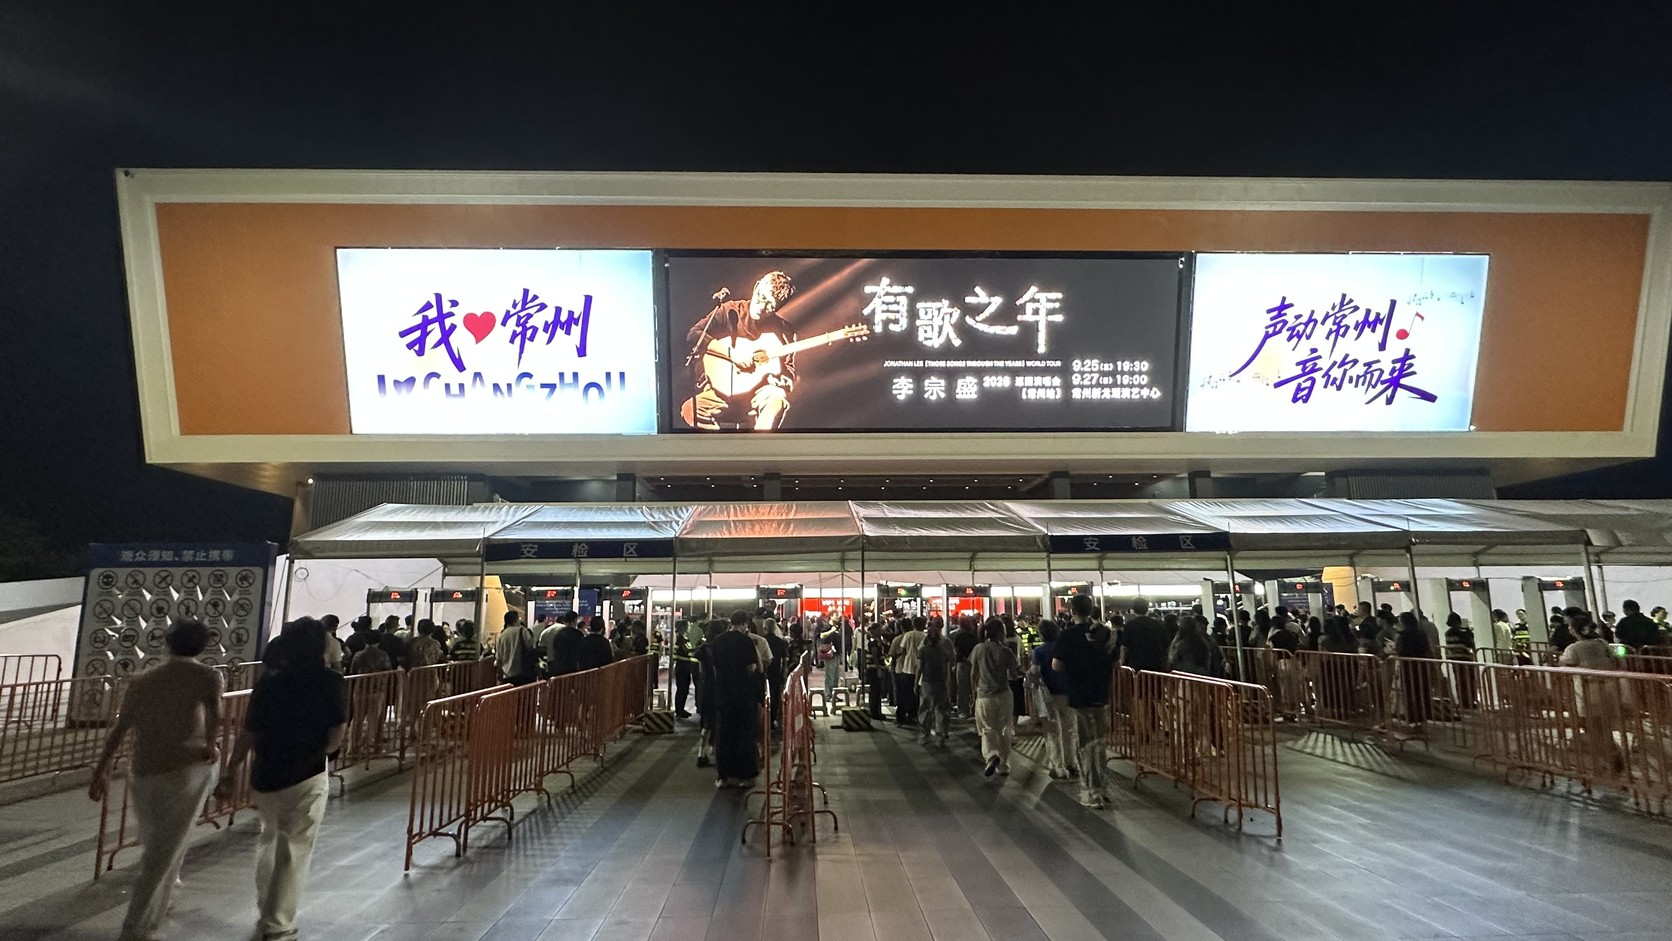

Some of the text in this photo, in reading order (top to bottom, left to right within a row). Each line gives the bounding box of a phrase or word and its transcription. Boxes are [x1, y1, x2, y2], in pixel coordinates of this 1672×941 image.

[862, 277, 1064, 354] 有歌之年
[1229, 293, 1397, 377] 声动常州
[1116, 360, 1149, 371] 19:30
[1116, 374, 1147, 385] 19:00
[1274, 348, 1438, 405] 音你而来
[1083, 535, 1195, 550] 安检区
[520, 543, 638, 558] 安检区
